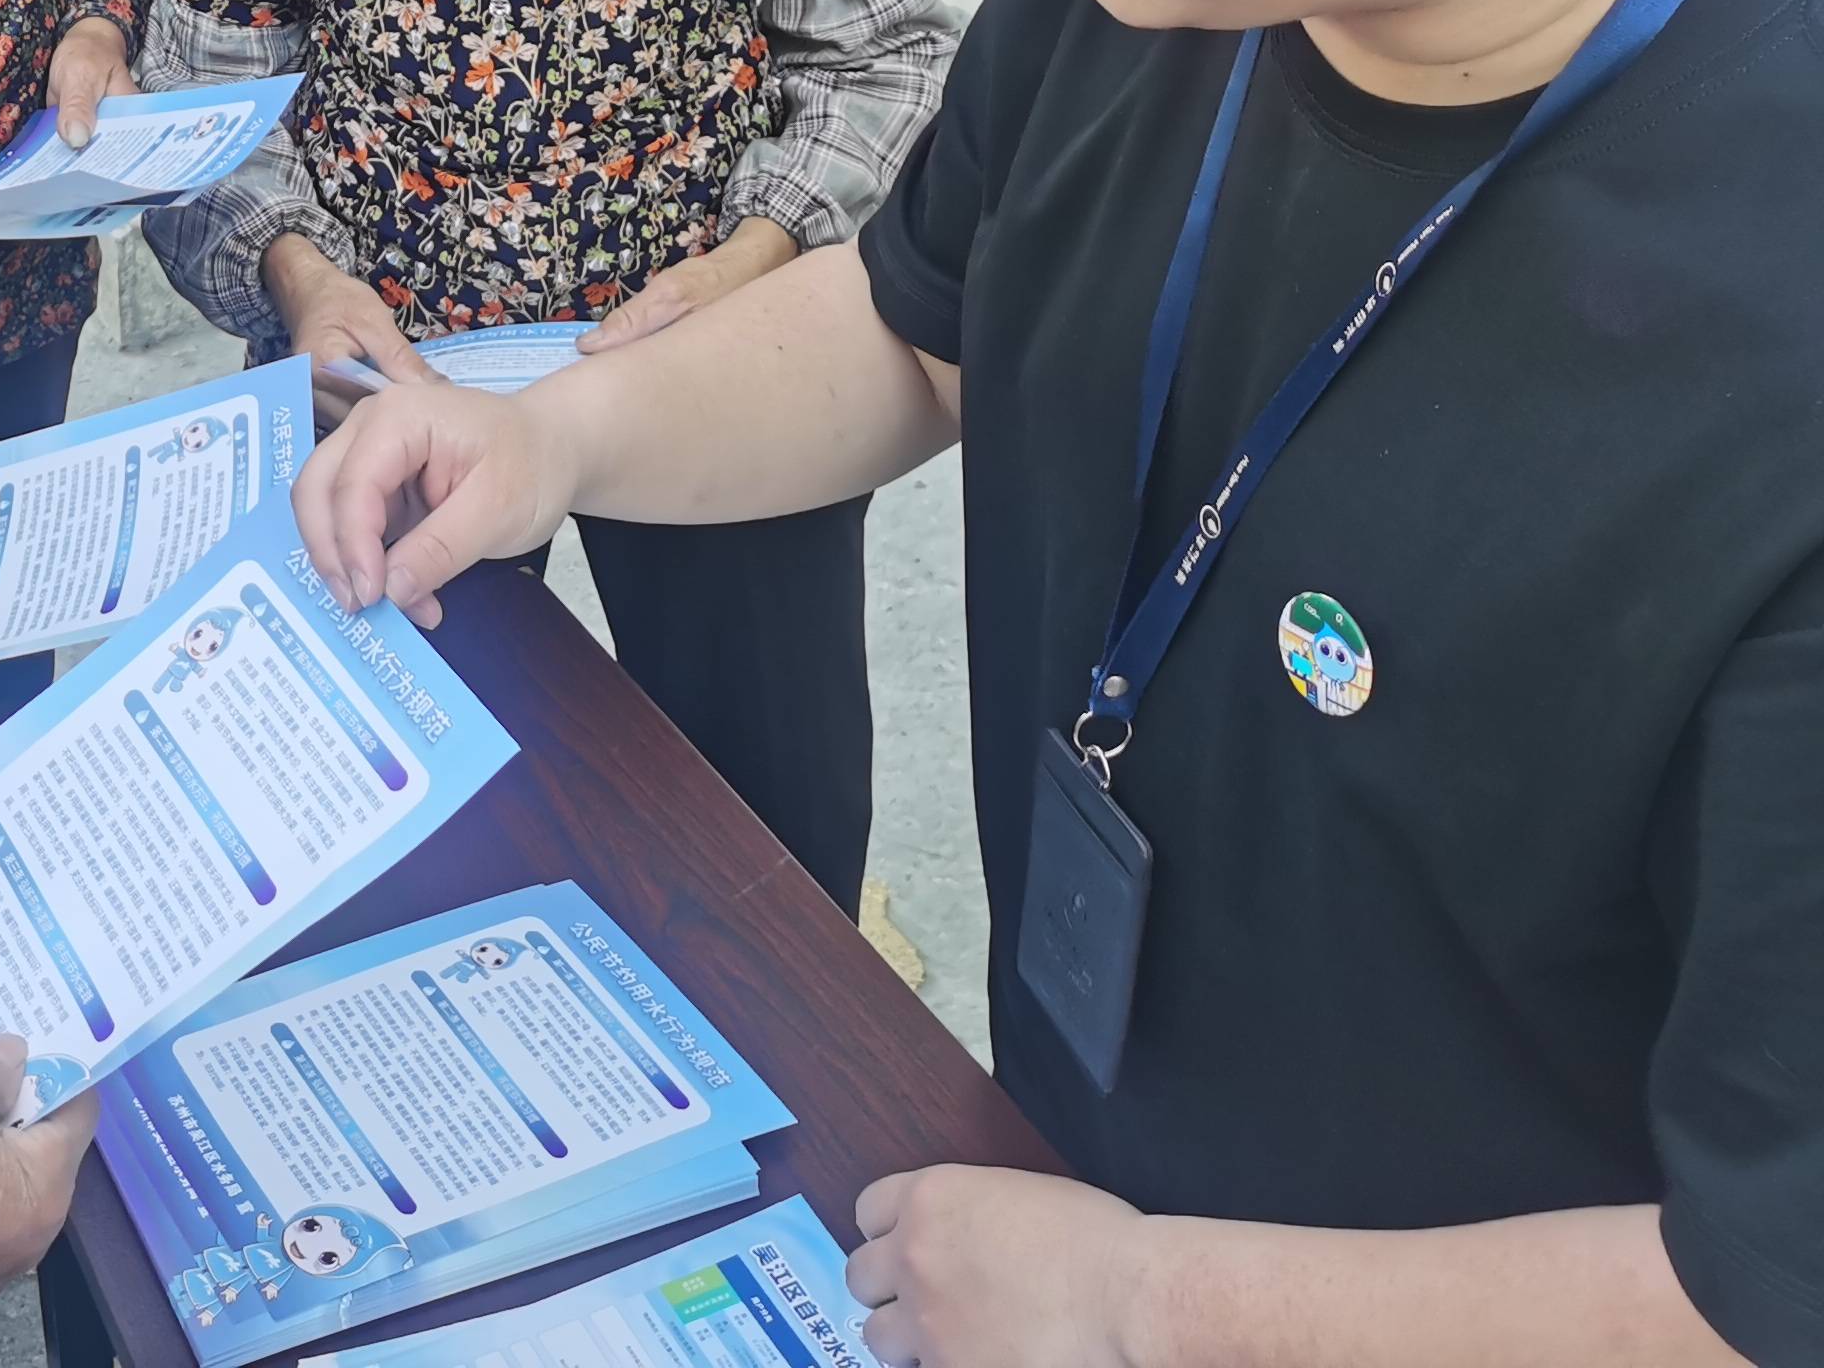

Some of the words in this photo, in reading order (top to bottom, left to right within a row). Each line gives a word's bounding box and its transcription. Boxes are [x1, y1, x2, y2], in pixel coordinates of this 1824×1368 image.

[565, 919, 736, 1091] 公民节约用水行为规范
[168, 1094, 243, 1197] 苏州市吴江区水务局
